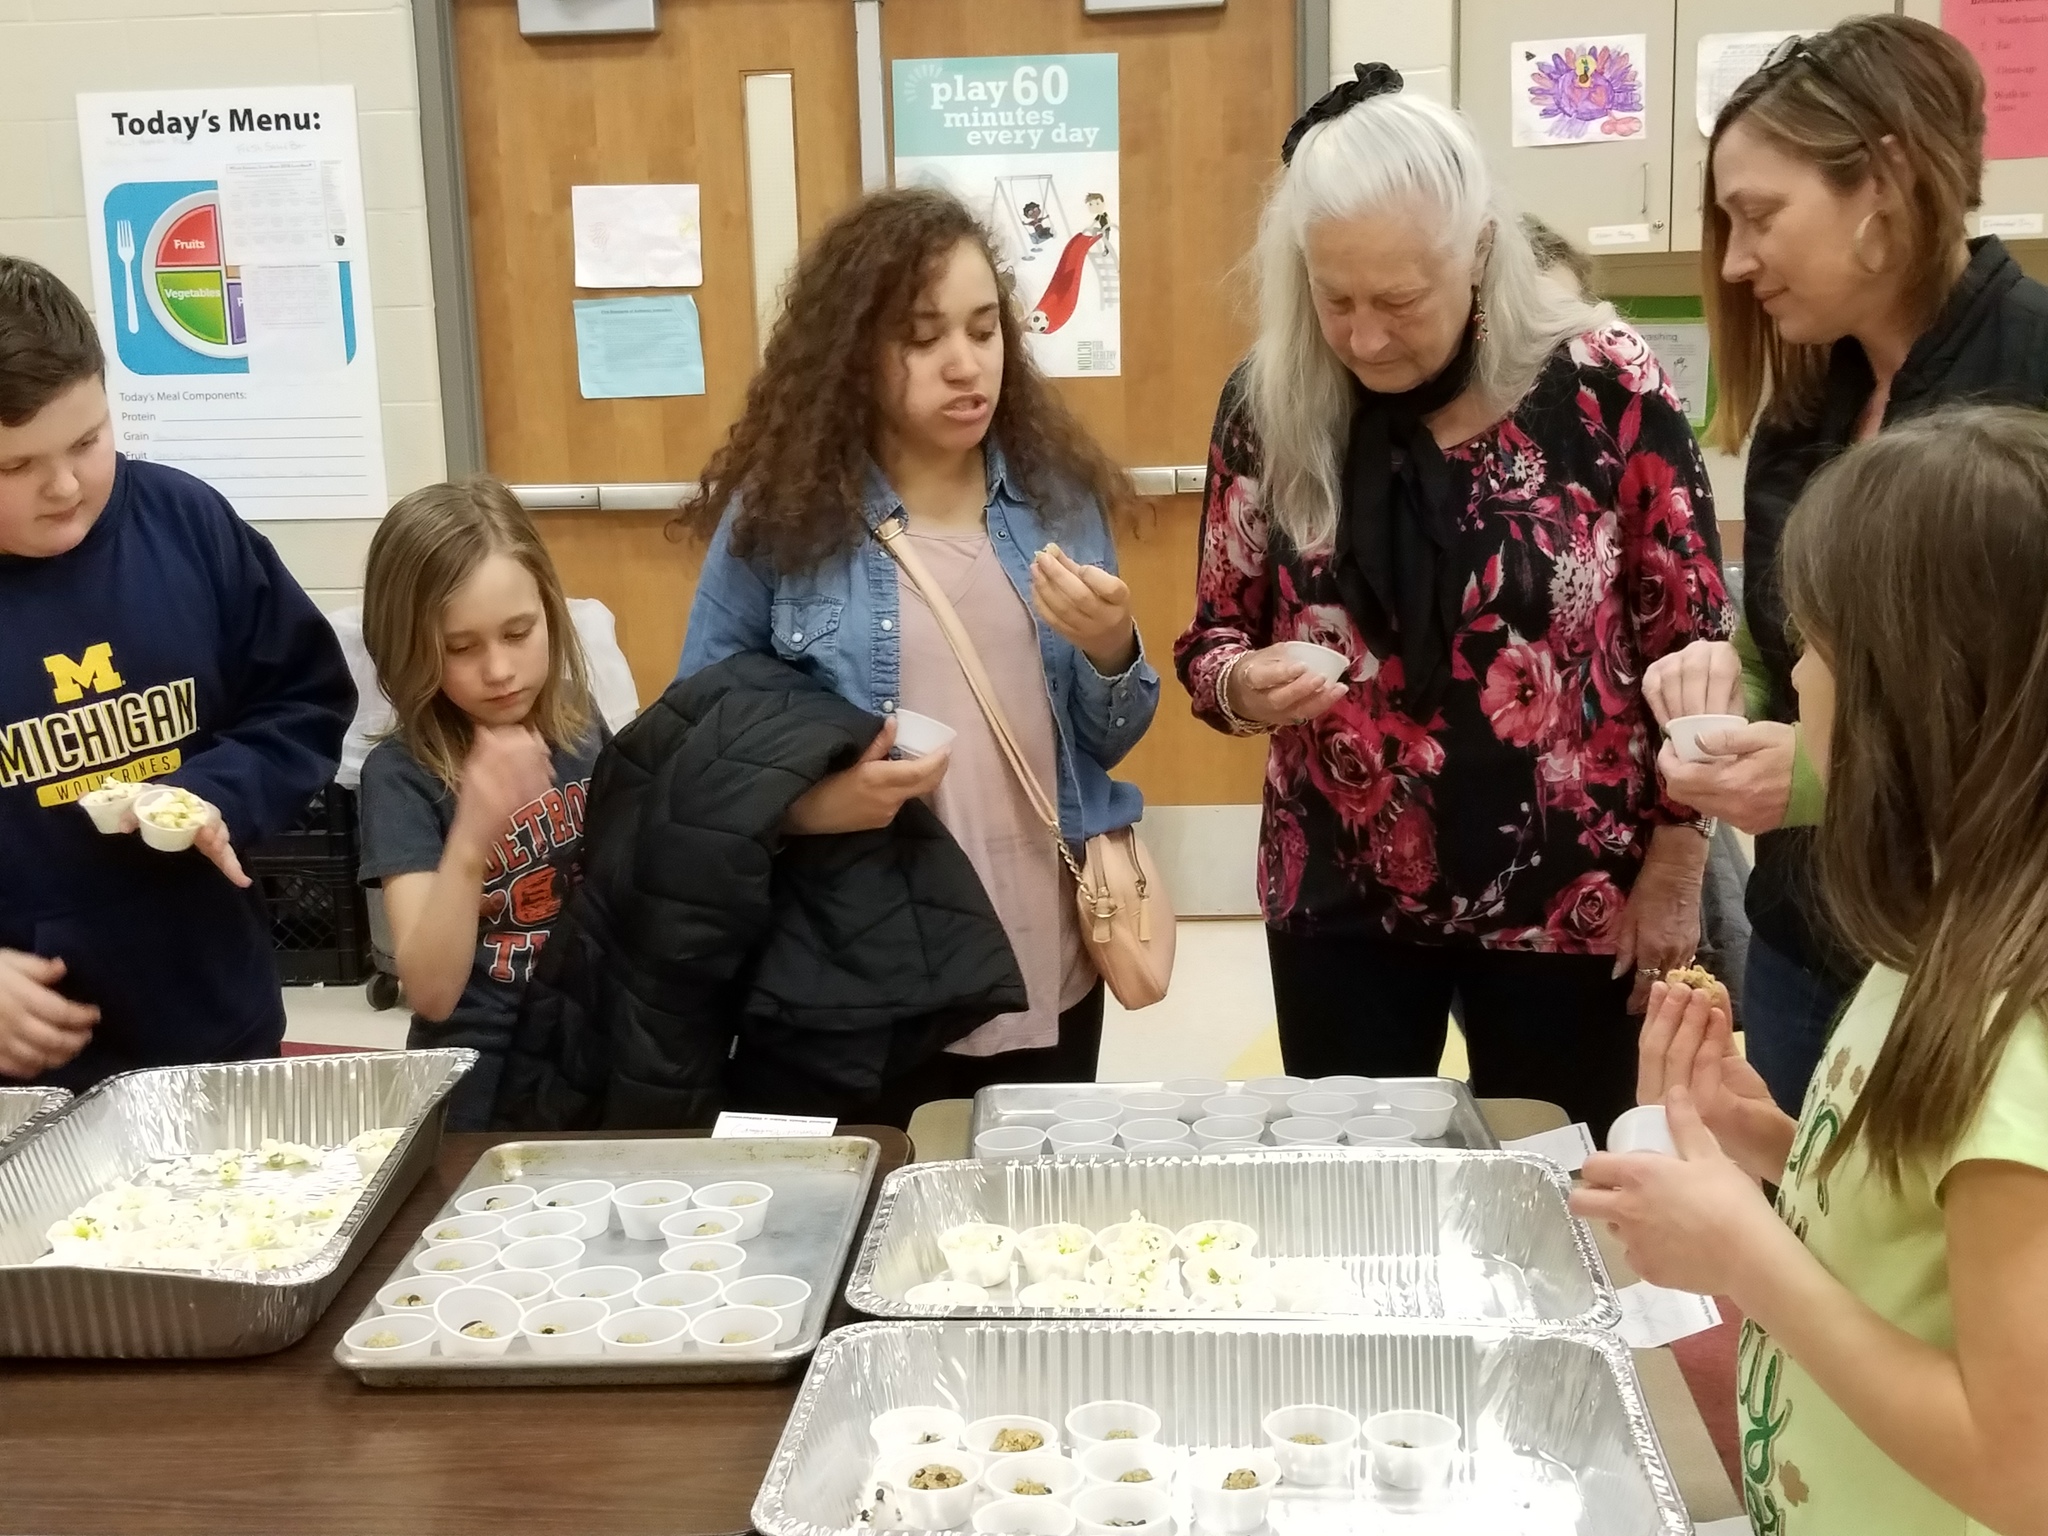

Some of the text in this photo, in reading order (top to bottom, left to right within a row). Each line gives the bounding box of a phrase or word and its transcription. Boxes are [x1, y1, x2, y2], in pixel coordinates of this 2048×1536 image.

[930, 64, 1069, 110] play 60
[111, 108, 322, 141] Today's Menu:
[943, 106, 1055, 128] minutes
[966, 122, 1100, 149] every day
[173, 238, 206, 250] Fruits
[163, 287, 222, 301] Vegetables
[119, 390, 247, 403] Today's Meal Components:
[122, 412, 156, 421] Protein
[123, 432, 149, 441] Grain
[126, 451, 147, 461] Fruit
[43, 641, 123, 704] M
[0, 677, 198, 788] MICHIGAN
